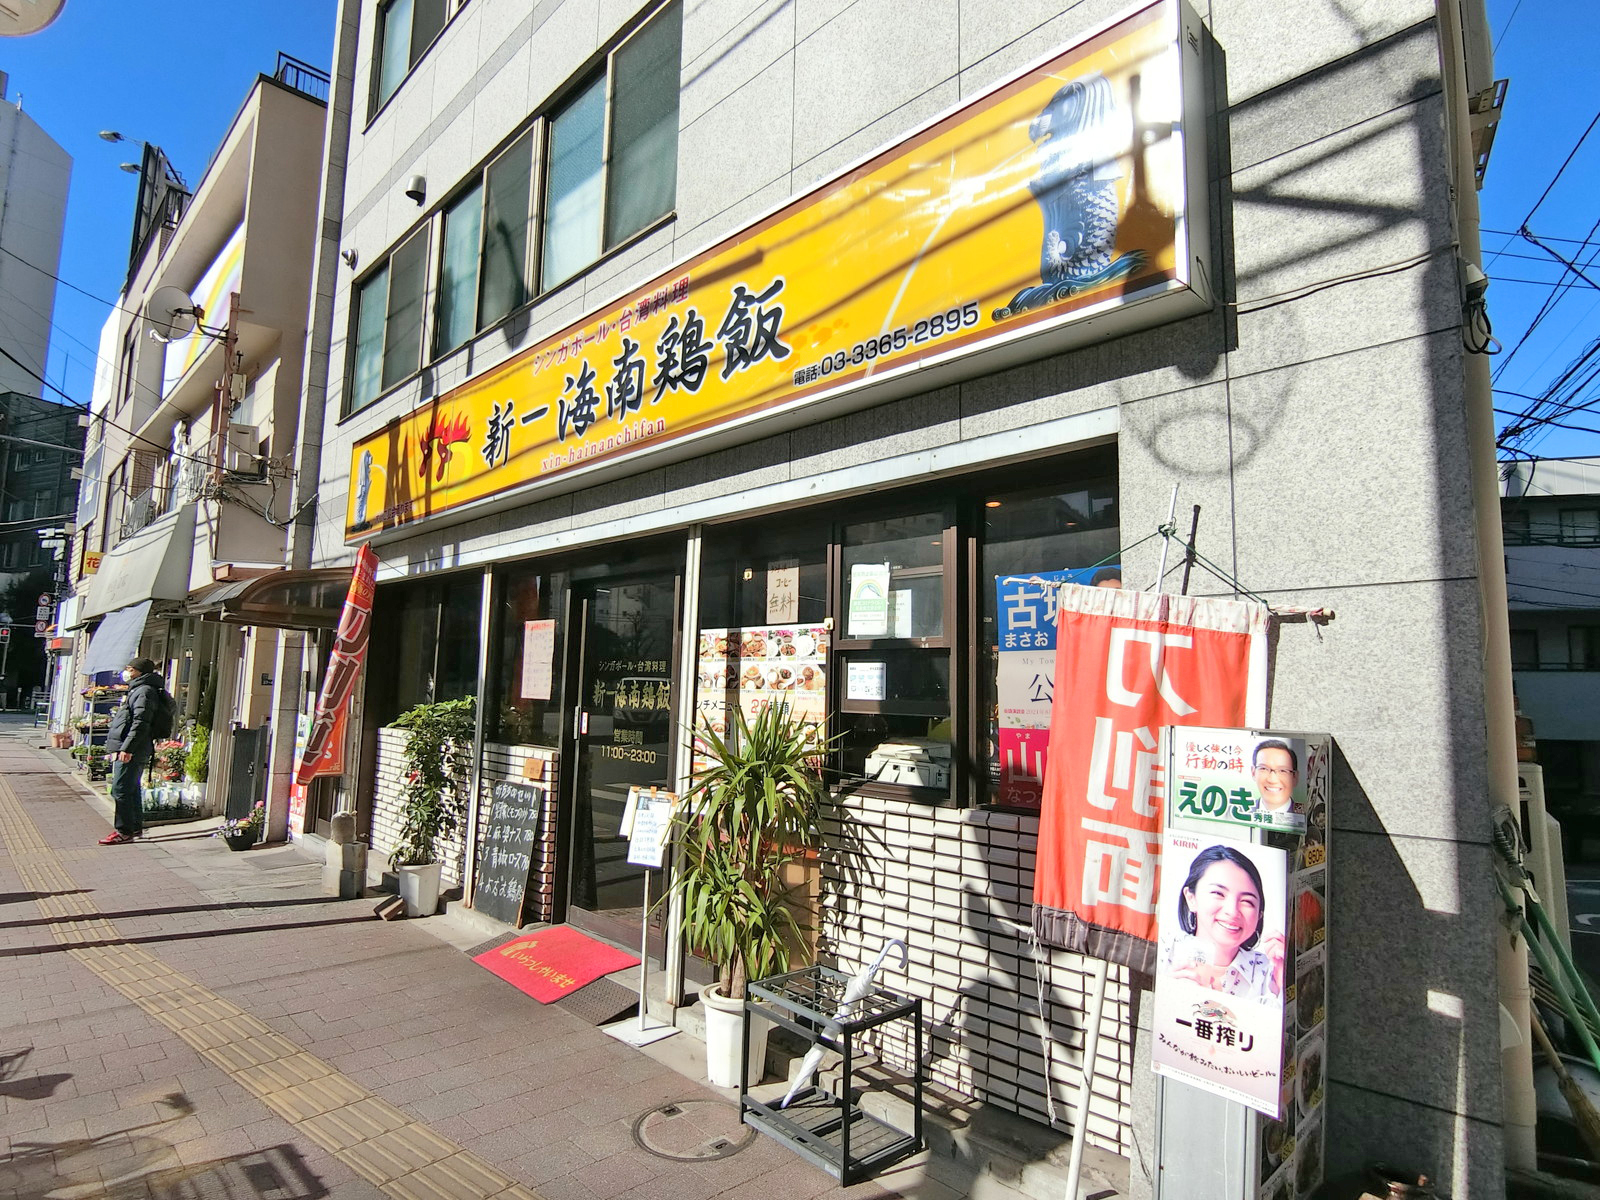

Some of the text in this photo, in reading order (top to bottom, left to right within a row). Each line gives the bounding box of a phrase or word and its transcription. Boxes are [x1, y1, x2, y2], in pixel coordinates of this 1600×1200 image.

[541, 419, 665, 471] xin-hainanchifan
[86, 557, 100, 569] 花
[769, 592, 795, 621] 無料
[1004, 631, 1049, 648] まさお
[613, 729, 644, 746] 営業時間
[1015, 732, 1031, 740] やま
[1185, 753, 1245, 774] 行動の時
[1007, 786, 1042, 804] なつ
[1177, 781, 1255, 822] えのき
[1173, 838, 1199, 850] KIRIN
[509, 950, 577, 989] いらっしゃいませ
[1175, 1017, 1254, 1052] 一番搾り
